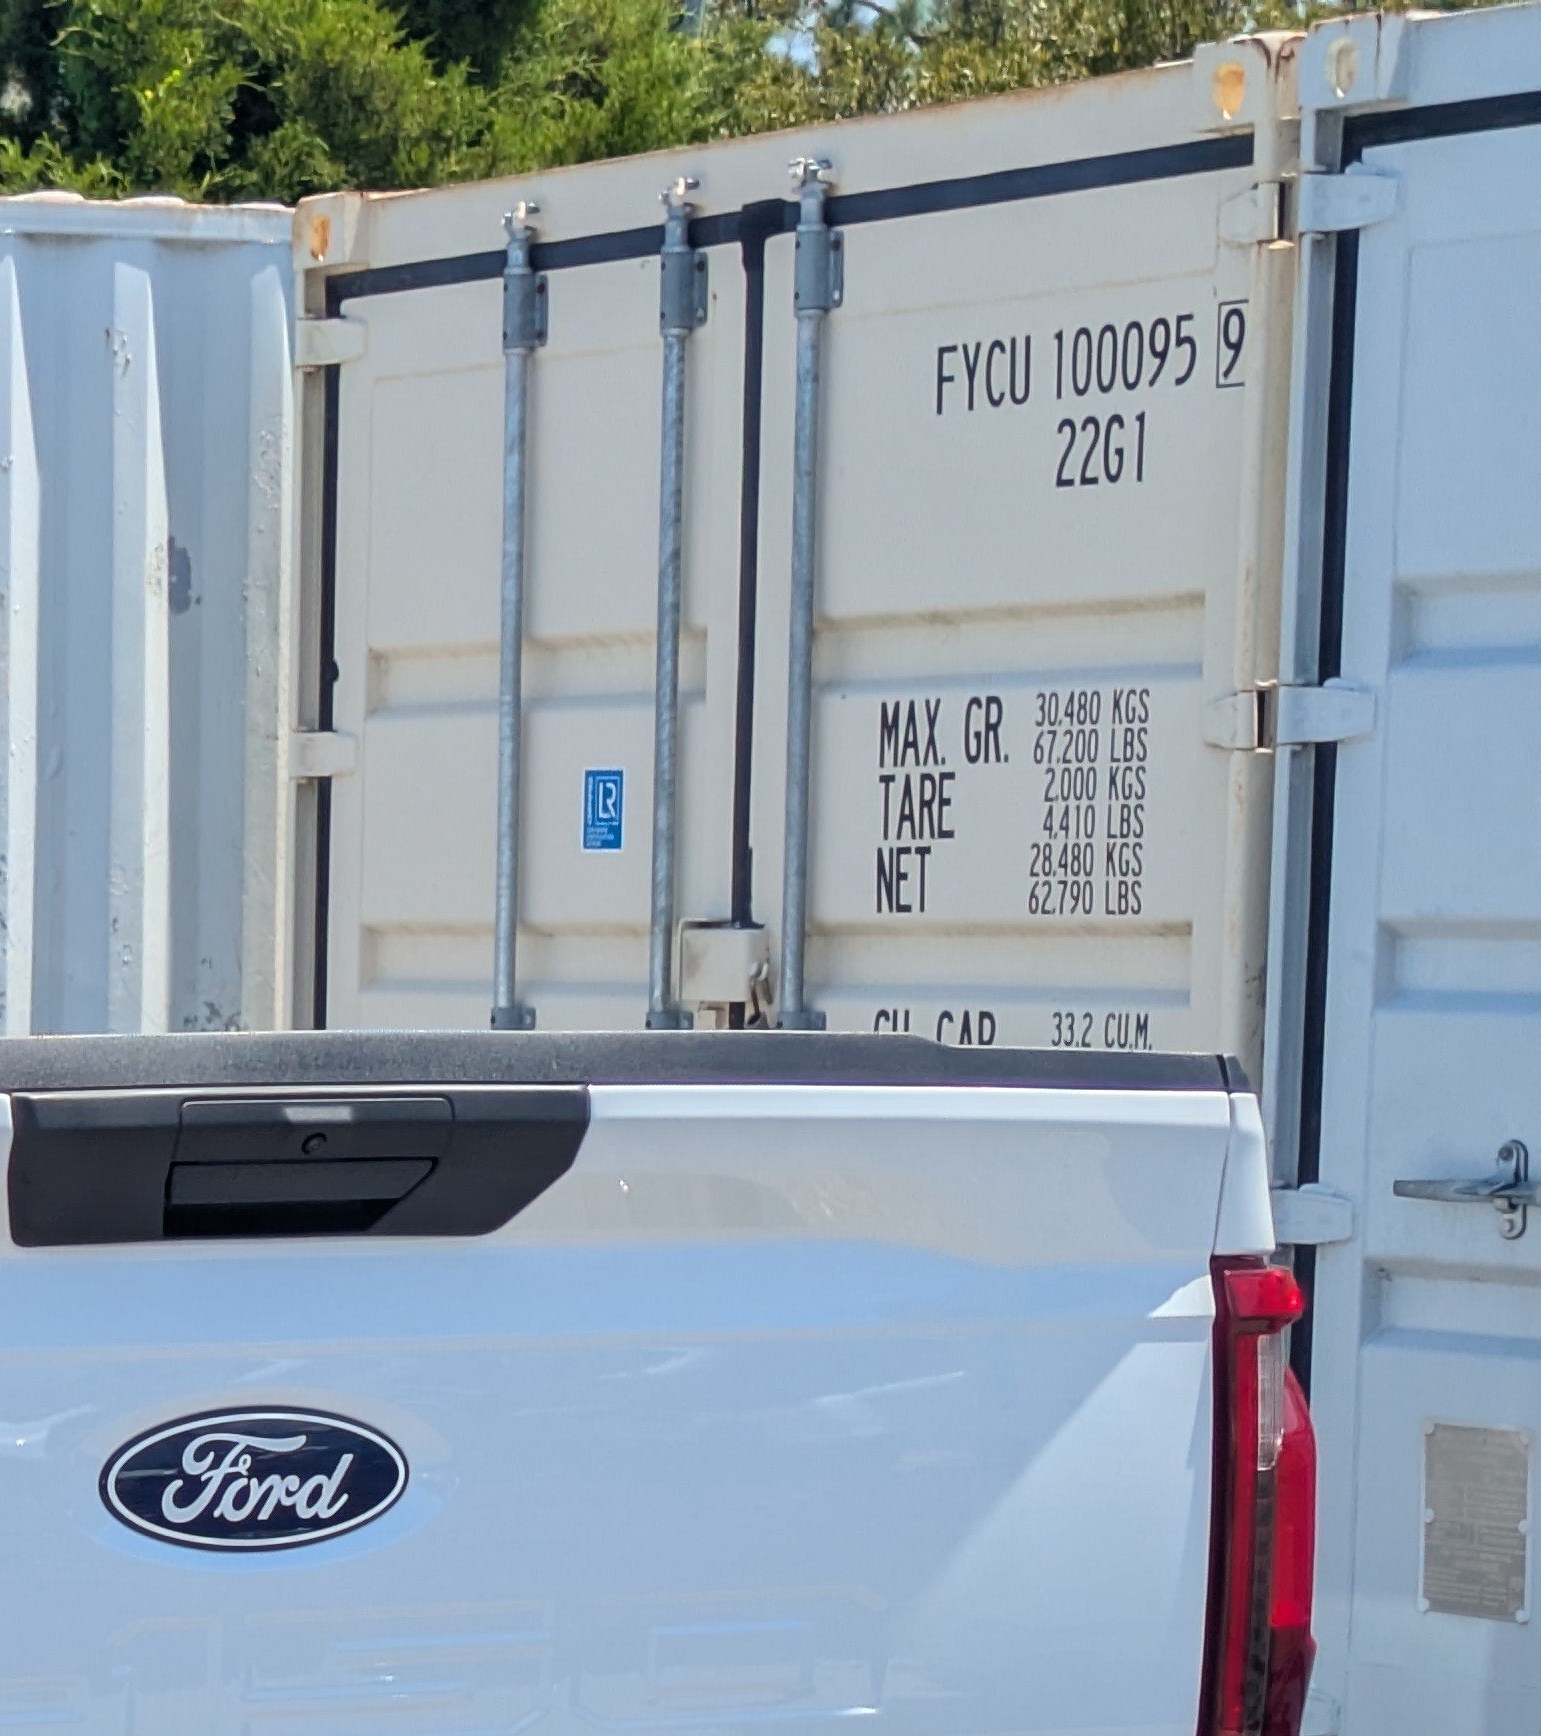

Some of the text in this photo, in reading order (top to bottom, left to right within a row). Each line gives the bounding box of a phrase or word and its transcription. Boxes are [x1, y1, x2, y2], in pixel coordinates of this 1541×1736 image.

[935, 307, 1246, 415] FYCU 100095 9
[1055, 410, 1146, 488] 22G1
[1112, 688, 1150, 725] KGS
[879, 695, 1009, 768] MAX. GR.
[1110, 727, 1148, 763] LBS
[1108, 766, 1146, 802] KGS
[879, 771, 956, 840] TARE
[1107, 803, 1144, 839] LBS
[1105, 842, 1143, 878] KGS
[877, 846, 931, 913] NET
[1104, 880, 1142, 915] LBS
[1051, 1012, 1093, 1048] 33.2
[161, 1433, 355, 1524] Ford
